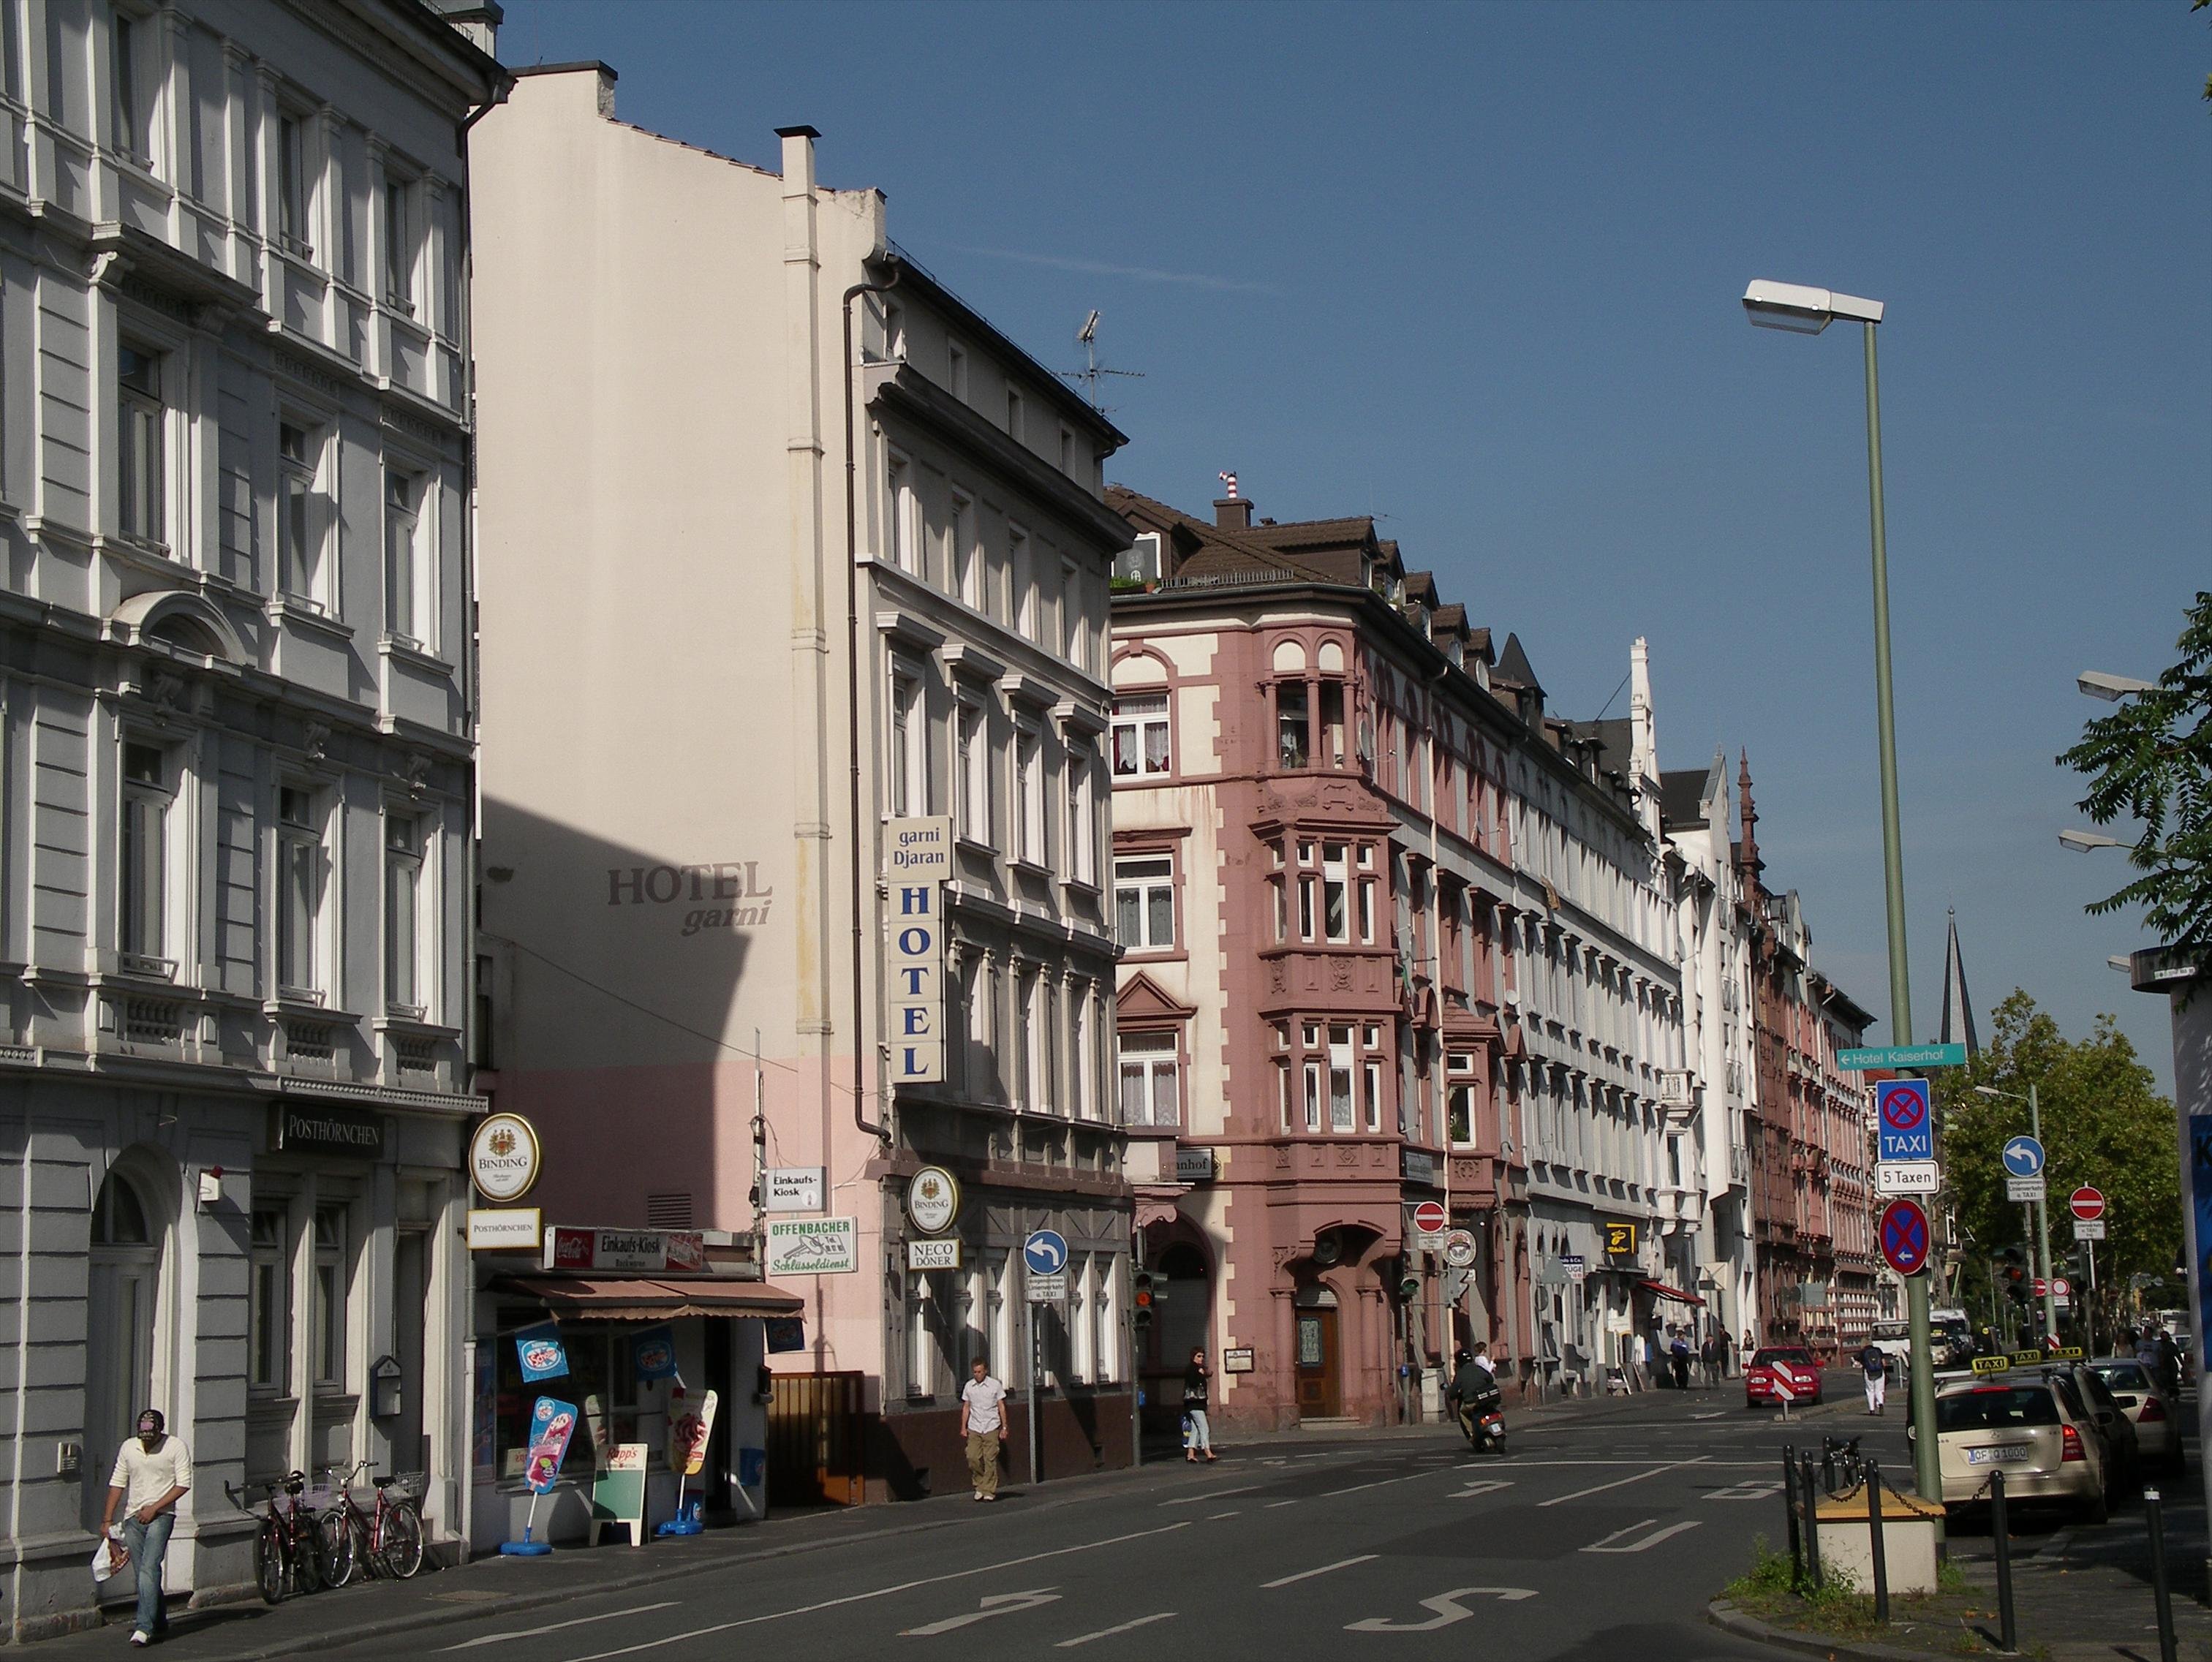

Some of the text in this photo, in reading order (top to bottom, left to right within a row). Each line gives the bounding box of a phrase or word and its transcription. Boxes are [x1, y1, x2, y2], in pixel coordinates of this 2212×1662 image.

[899, 827, 940, 847] garni
[894, 850, 945, 869] Djaran
[608, 861, 773, 905] HOTEL
[681, 899, 772, 937] garni
[899, 887, 931, 1075] HOTEL
[1853, 1049, 1944, 1065] Hotel Kaiserhof
[289, 1114, 380, 1145] POSTHÖRNCHEN
[1884, 1135, 1927, 1153] TAXI
[479, 1156, 527, 1170] BINDING
[774, 1175, 818, 1185] Einkaufs-
[1884, 1171, 1931, 1183] 5 Taxen
[774, 1187, 800, 1196] Kiosk
[914, 1200, 948, 1209] BINDING
[474, 1224, 533, 1233] POSTHÖRNCHEN
[772, 1221, 850, 1236] OFFENBACHER
[601, 1235, 661, 1254] Einkaufs-Kiosk
[914, 1243, 954, 1256] NECO
[772, 1258, 849, 1272] Schlüsseldienst
[1977, 1360, 2003, 1369] TAXI
